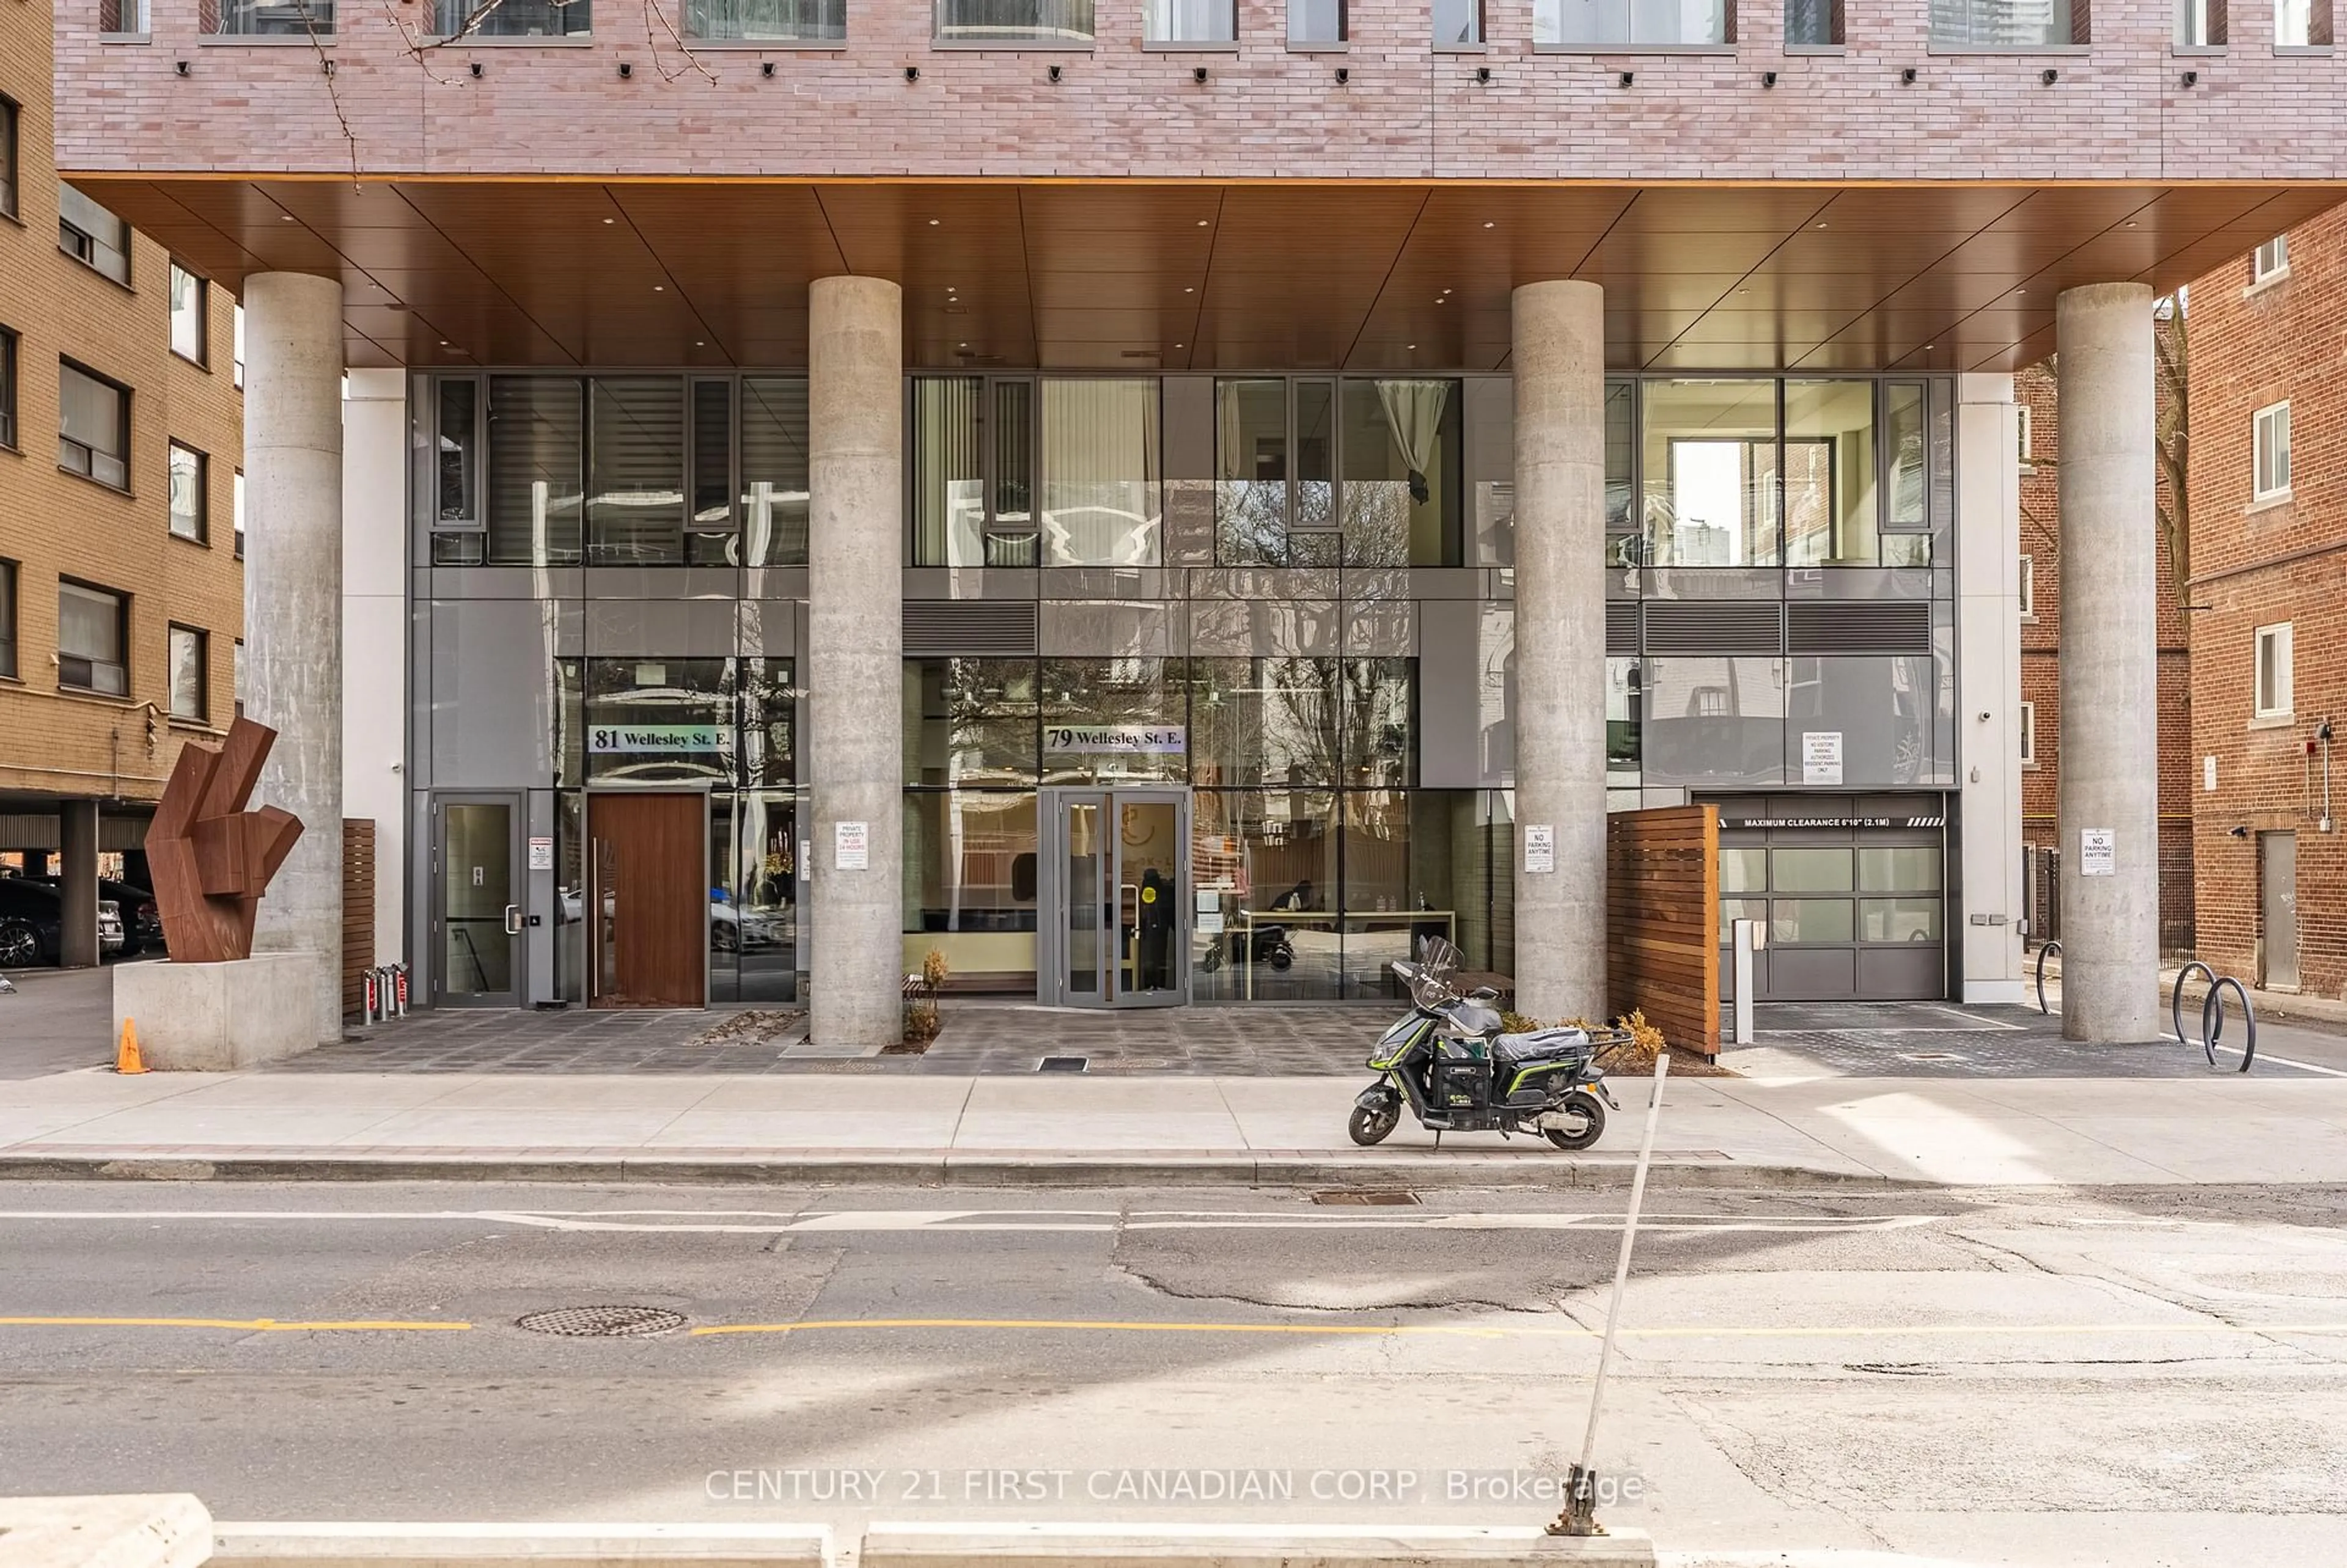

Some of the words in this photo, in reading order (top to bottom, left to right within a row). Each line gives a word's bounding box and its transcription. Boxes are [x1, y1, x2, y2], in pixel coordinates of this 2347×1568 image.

[595, 730, 618, 749] 81
[624, 733, 688, 748] Wellesley
[692, 733, 711, 746] St.
[716, 733, 730, 746] E.
[1048, 729, 1073, 748] 79
[1077, 731, 1140, 747] Wellesley
[1144, 731, 1162, 744] St.
[1167, 731, 1181, 744] E.
[1864, 818, 1890, 827] (2.1M)
